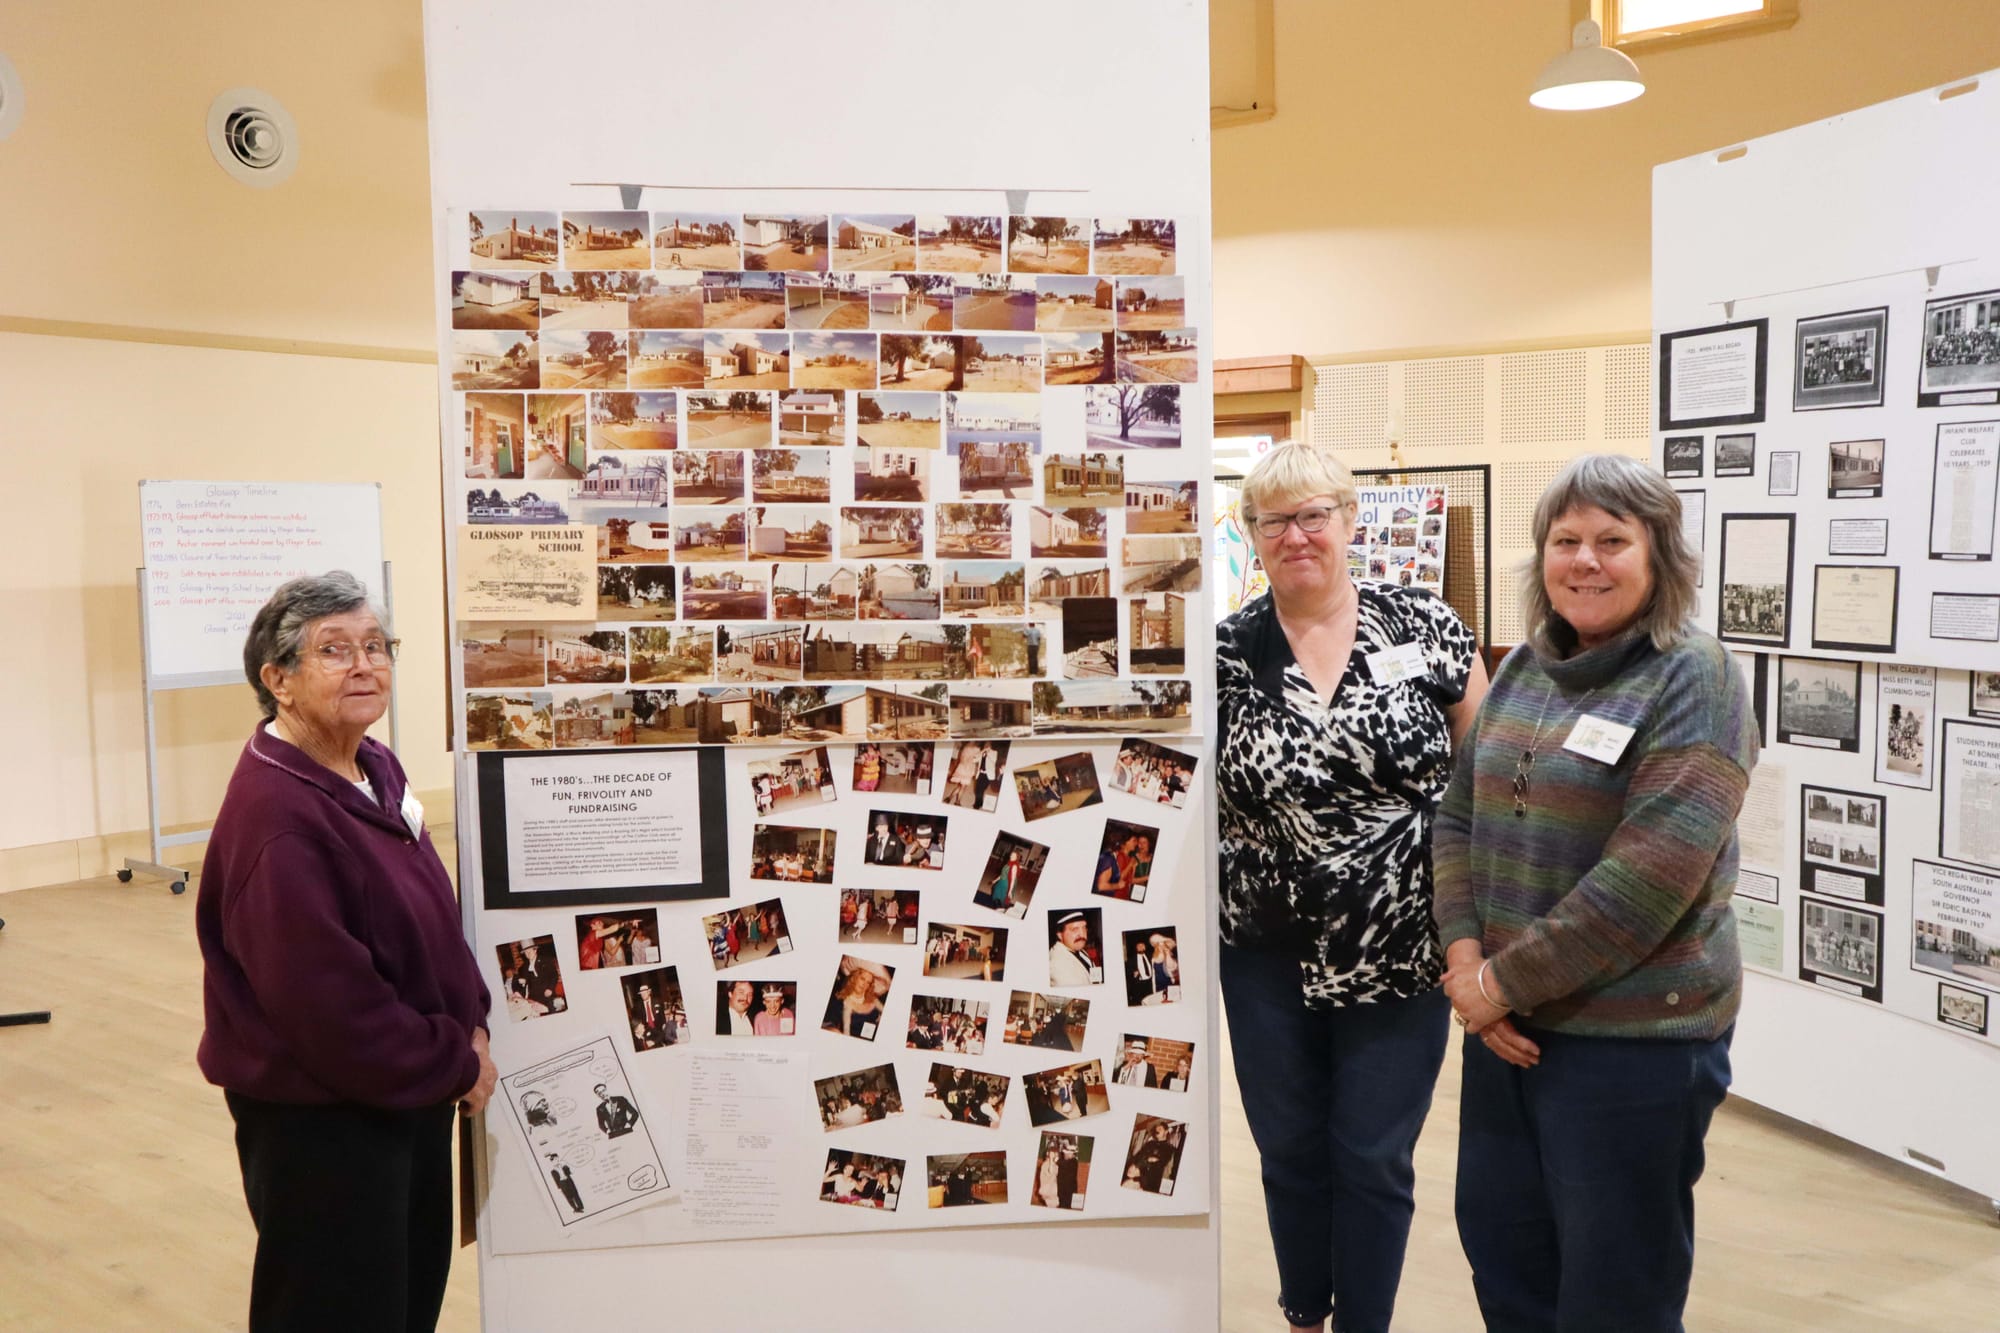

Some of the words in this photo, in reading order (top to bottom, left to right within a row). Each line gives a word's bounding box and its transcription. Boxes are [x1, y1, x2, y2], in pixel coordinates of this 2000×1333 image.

[1968, 426, 1994, 434] WELFARE
[244, 485, 279, 496] Timeline
[470, 529, 524, 540] GLOSSOP
[530, 530, 584, 540] PRIMARY
[538, 543, 584, 553] SCHOOL
[1888, 664, 1898, 672] THE
[1900, 666, 1919, 674] CLASS
[1897, 676, 1912, 684] BETTY
[1884, 688, 1913, 696] CLIMBING
[1914, 690, 1931, 698] HIGH
[1956, 737, 1986, 747] STUDENTS
[530, 777, 548, 786] THE
[614, 773, 655, 782] DECADE
[658, 772, 672, 782] OF
[578, 790, 626, 800] FRIVOLITY
[630, 788, 653, 798] AND
[568, 802, 638, 814] FUNDRAISING
[1932, 868, 1946, 876] VICE
[1948, 870, 1968, 880] REGAL
[1970, 876, 1984, 884] VISIT
[1932, 878, 1952, 888] SOUTH
[1954, 884, 1992, 896] AUSTRALIAN
[1944, 891, 1980, 904] GOVERNOR
[1942, 902, 1960, 912] EDRIC
[1962, 908, 1992, 919] BASTYAN
[1938, 913, 1968, 925] FEBRUARY
